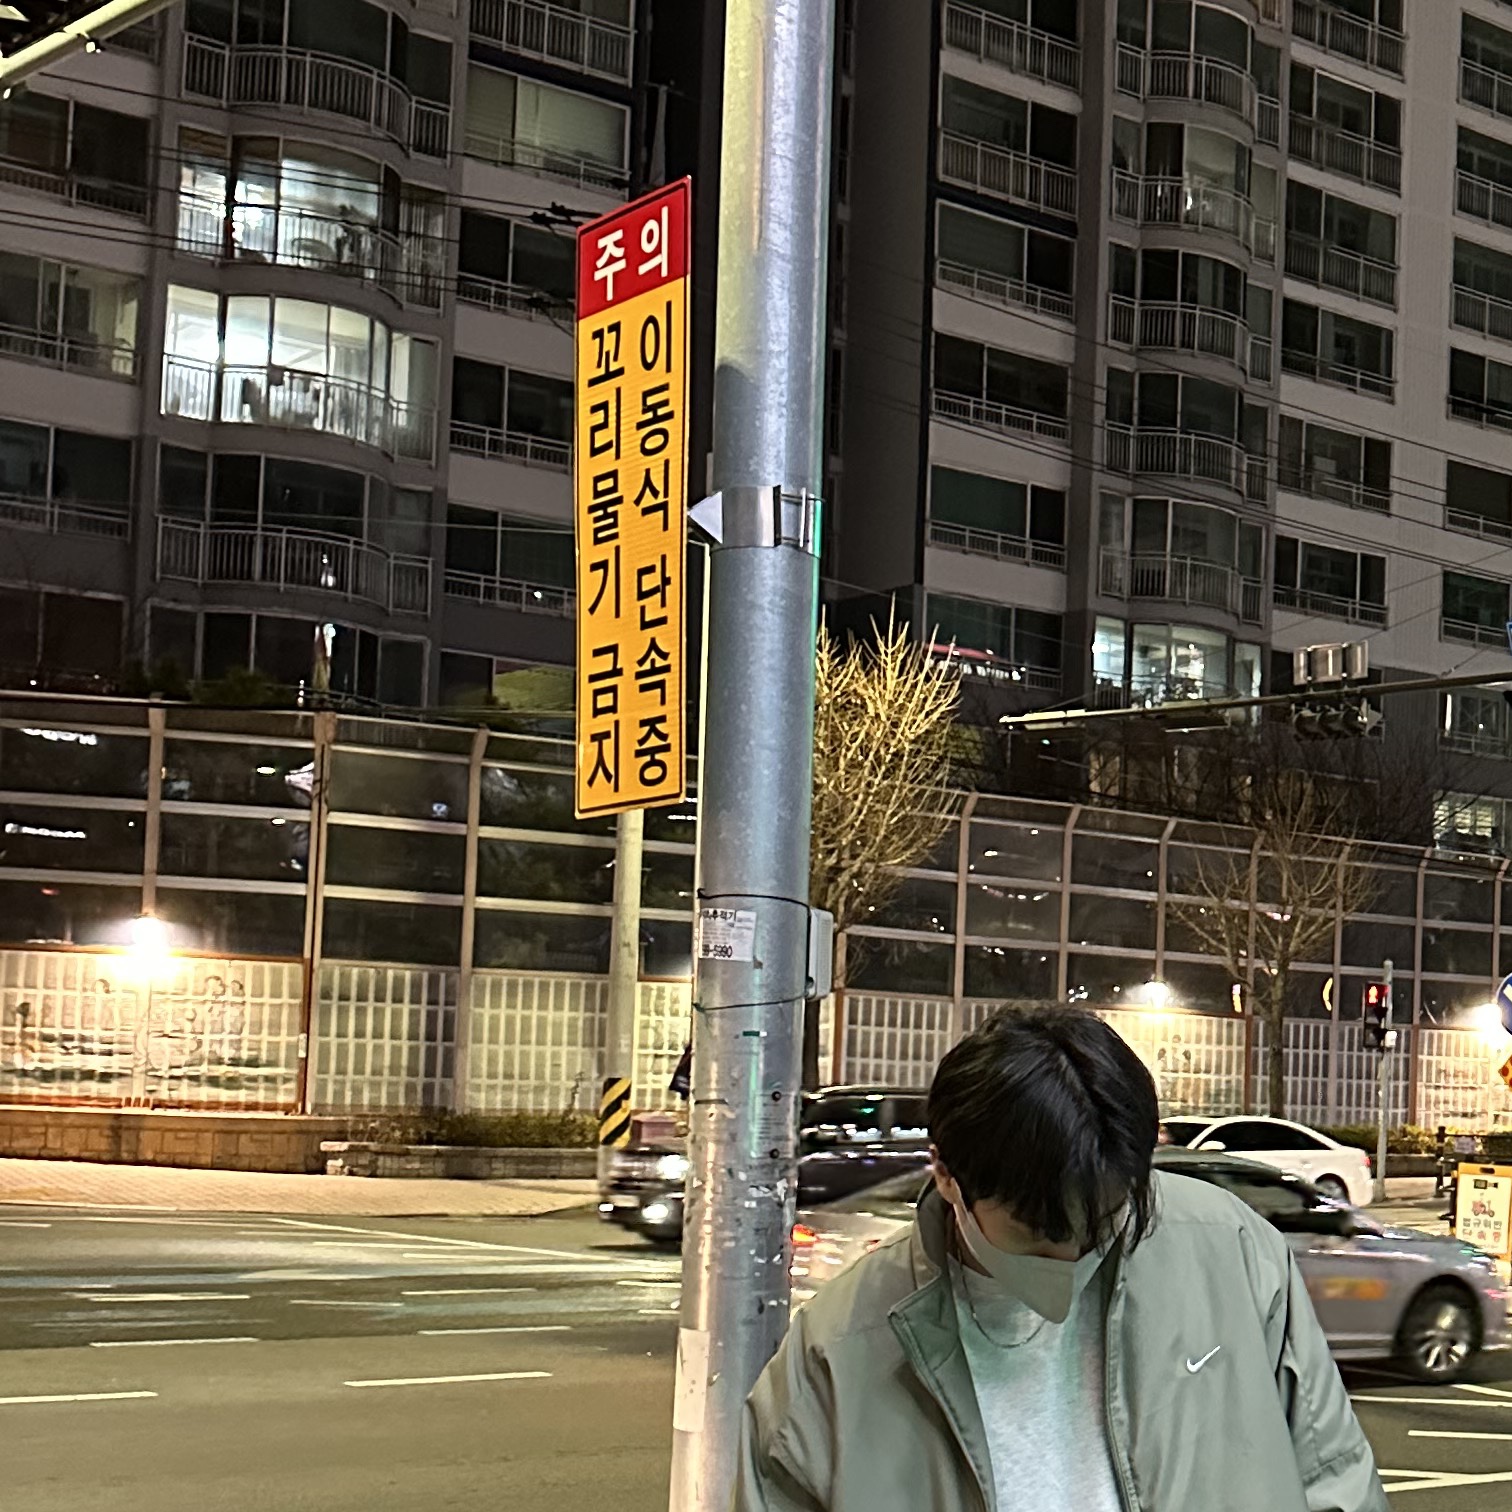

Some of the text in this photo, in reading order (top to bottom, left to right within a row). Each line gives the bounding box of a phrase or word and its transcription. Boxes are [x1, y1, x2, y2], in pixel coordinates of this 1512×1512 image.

[594, 205, 668, 301] 주의
[588, 324, 624, 793] 꼬리물기 금지
[635, 300, 674, 789] 이동식 단속중
